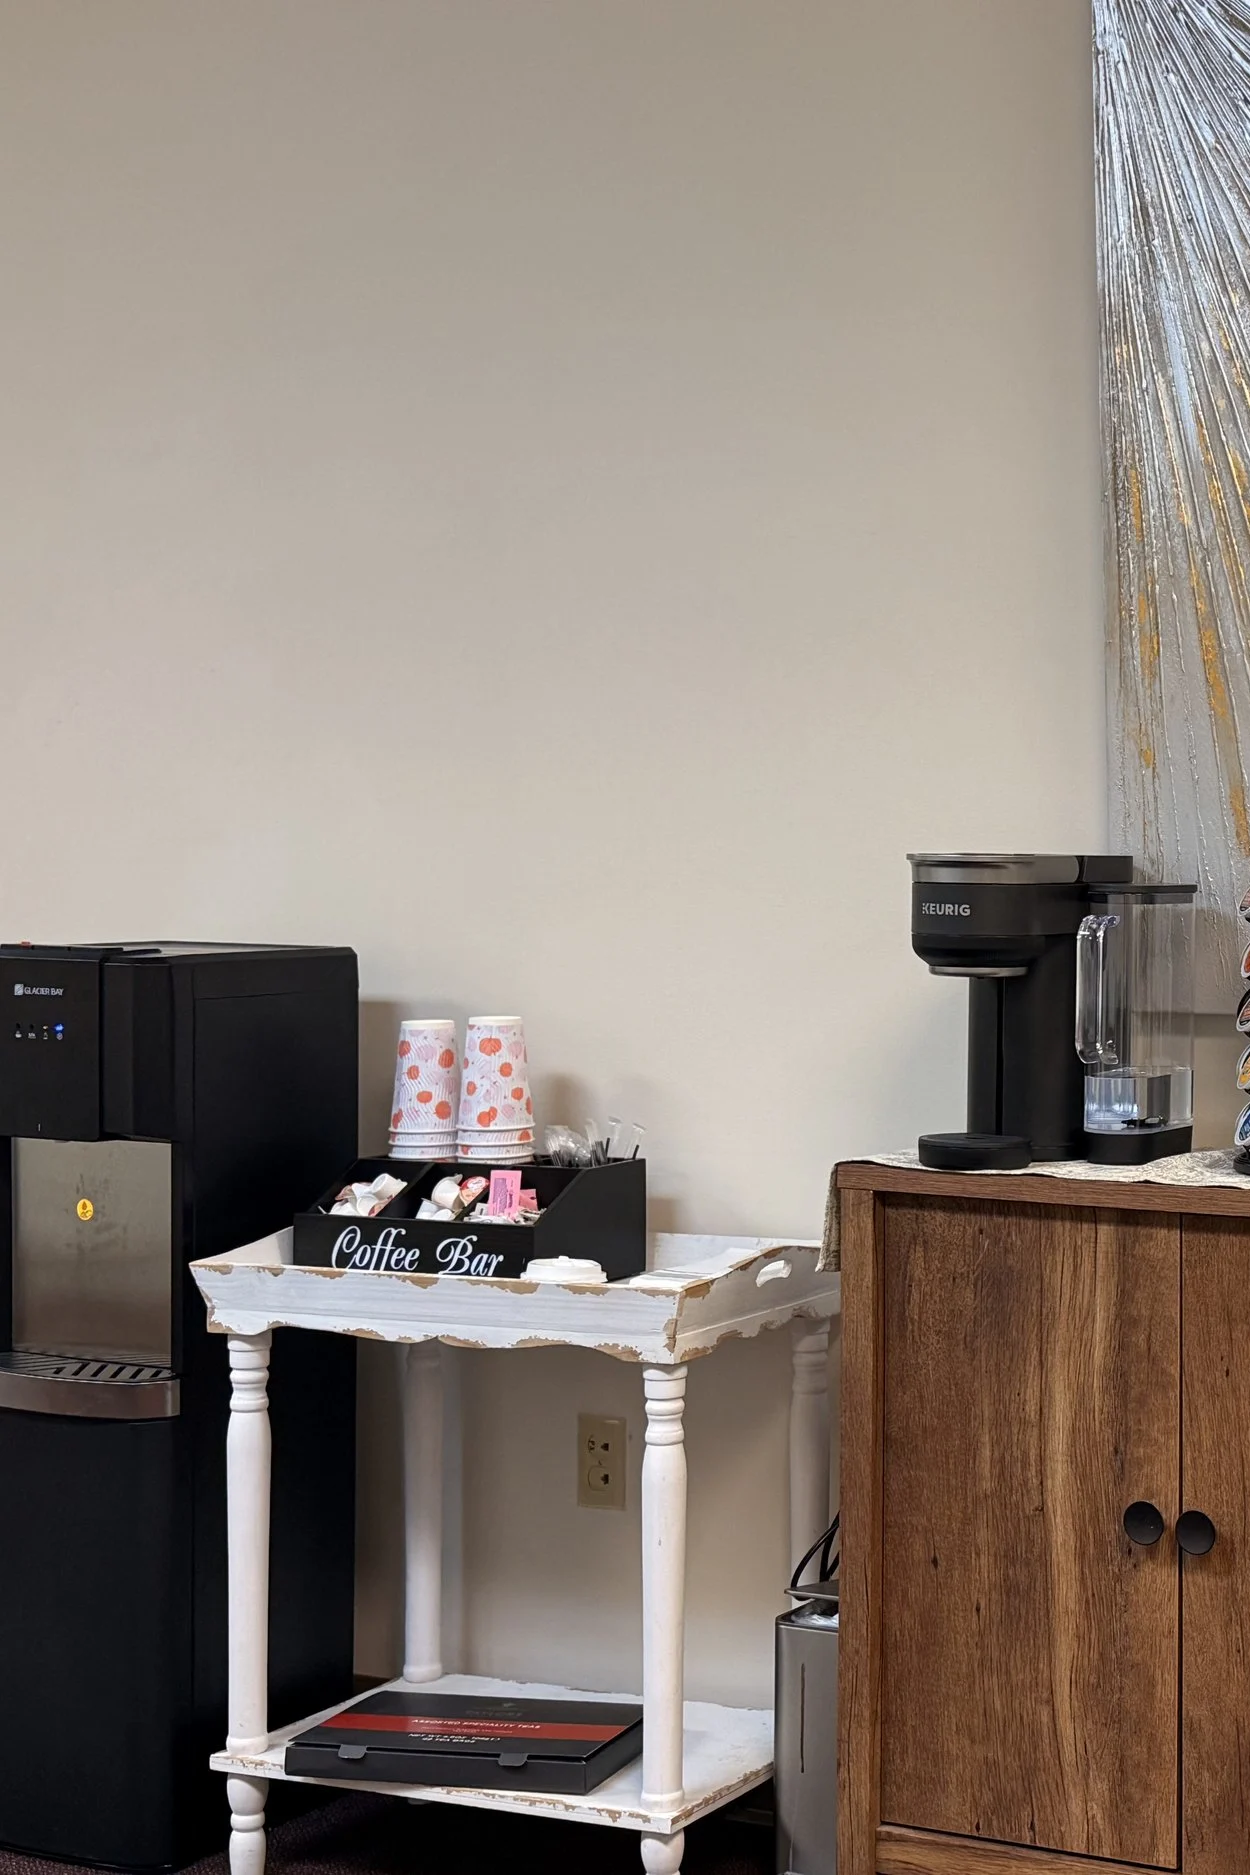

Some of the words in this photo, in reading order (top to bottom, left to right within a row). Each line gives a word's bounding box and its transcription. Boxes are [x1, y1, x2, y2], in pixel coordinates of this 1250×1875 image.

[922, 903, 970, 916] KEURIG
[24, 986, 50, 995] GLACIER
[51, 988, 64, 996] BAY
[331, 1225, 420, 1271] Coffee
[436, 1235, 504, 1277] Bar
